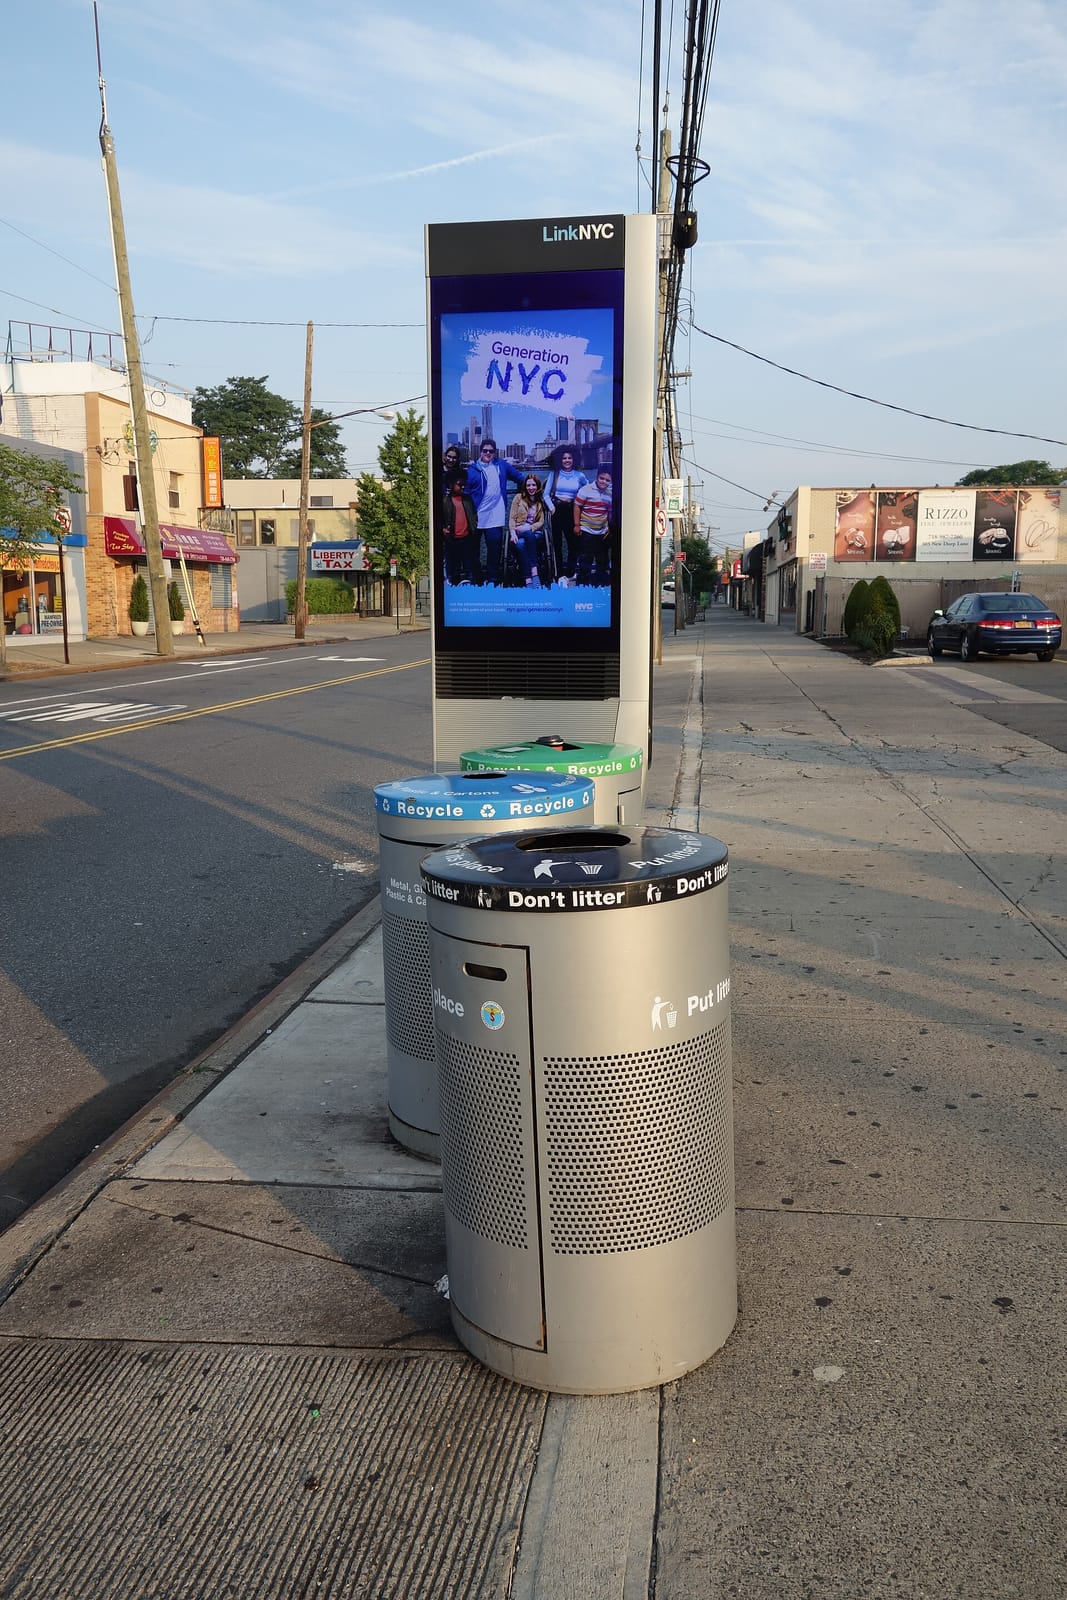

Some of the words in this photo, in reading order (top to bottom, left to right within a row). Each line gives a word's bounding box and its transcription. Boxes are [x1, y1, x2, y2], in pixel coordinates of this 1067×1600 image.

[543, 223, 614, 242] LinkNYC
[491, 341, 569, 365] Generation
[485, 358, 567, 401] NYC
[925, 507, 969, 520] RIZZO
[313, 550, 355, 560] LIBERTY
[322, 559, 353, 569] TAX
[568, 761, 623, 776] Recycle
[397, 801, 464, 819] Recycle
[509, 796, 574, 816] Recycle
[431, 879, 460, 901] litter
[676, 870, 713, 895] Don't
[509, 890, 565, 908] Don't
[573, 889, 626, 907] litter
[433, 988, 464, 1018] place
[687, 995, 714, 1017] Put
